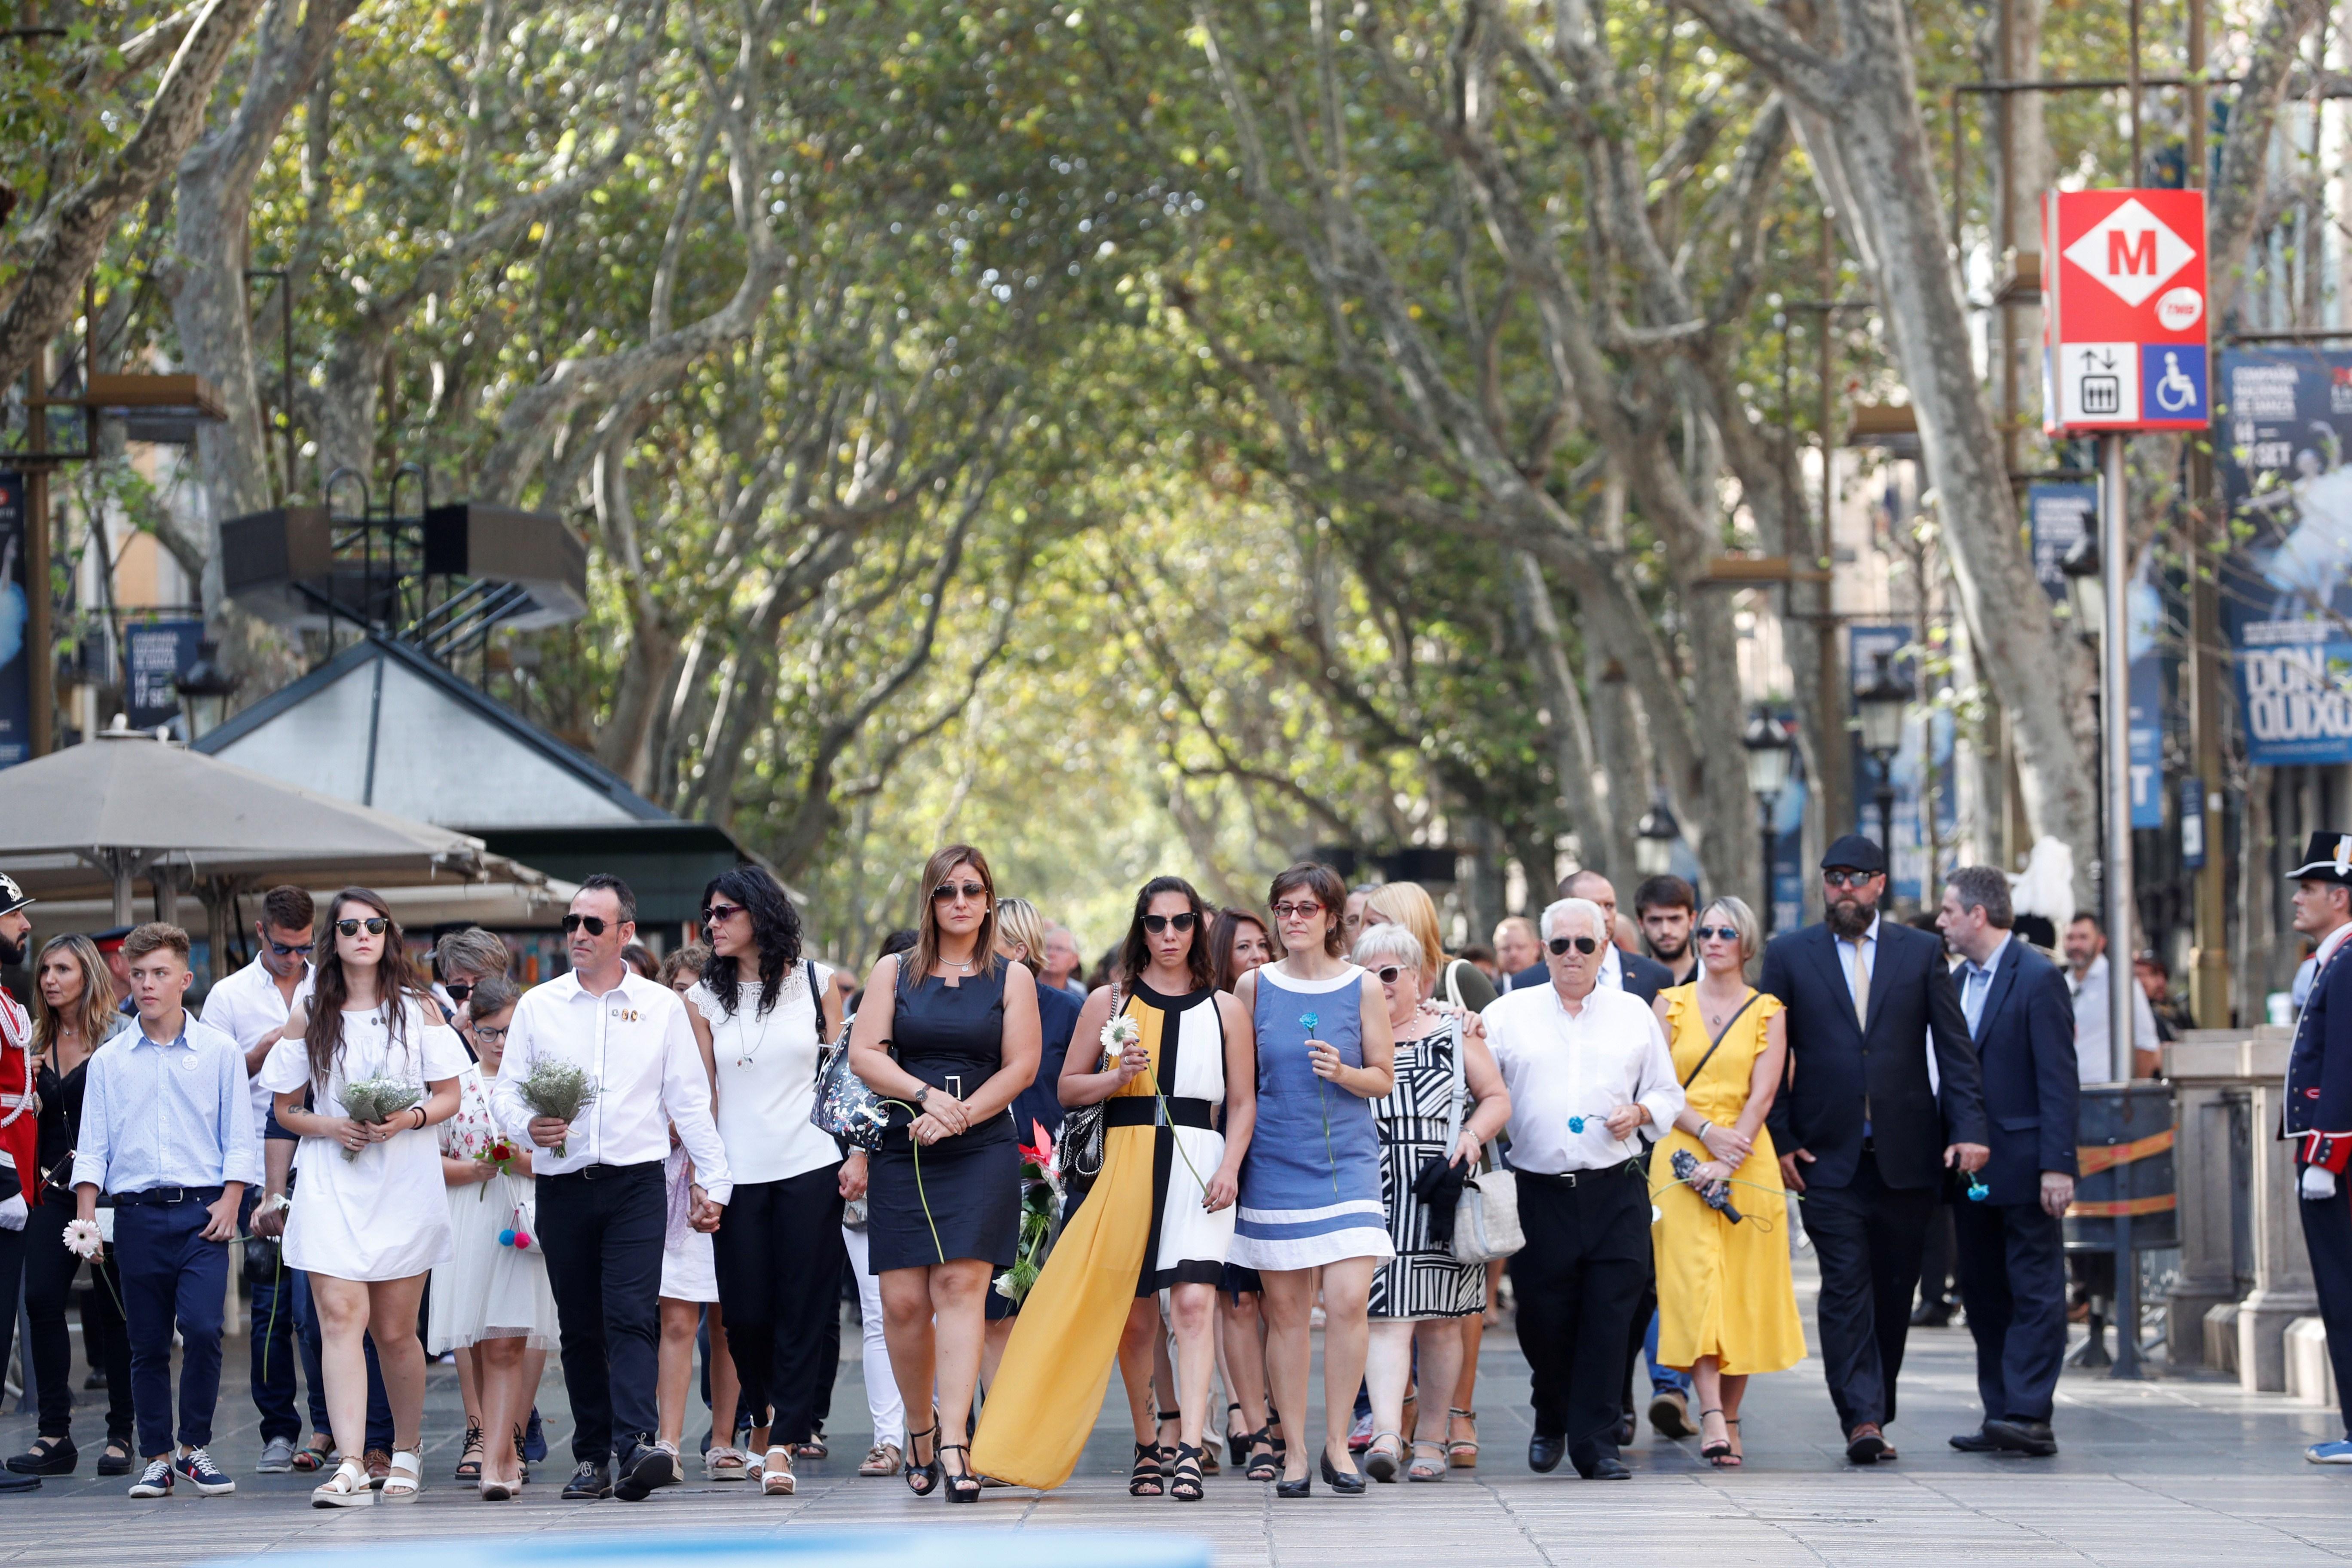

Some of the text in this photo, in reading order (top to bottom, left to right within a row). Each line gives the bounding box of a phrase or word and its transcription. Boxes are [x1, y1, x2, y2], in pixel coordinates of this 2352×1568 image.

[2108, 230, 2157, 275] M
[2256, 441, 2292, 468] SET
[2243, 645, 2324, 694] DON
